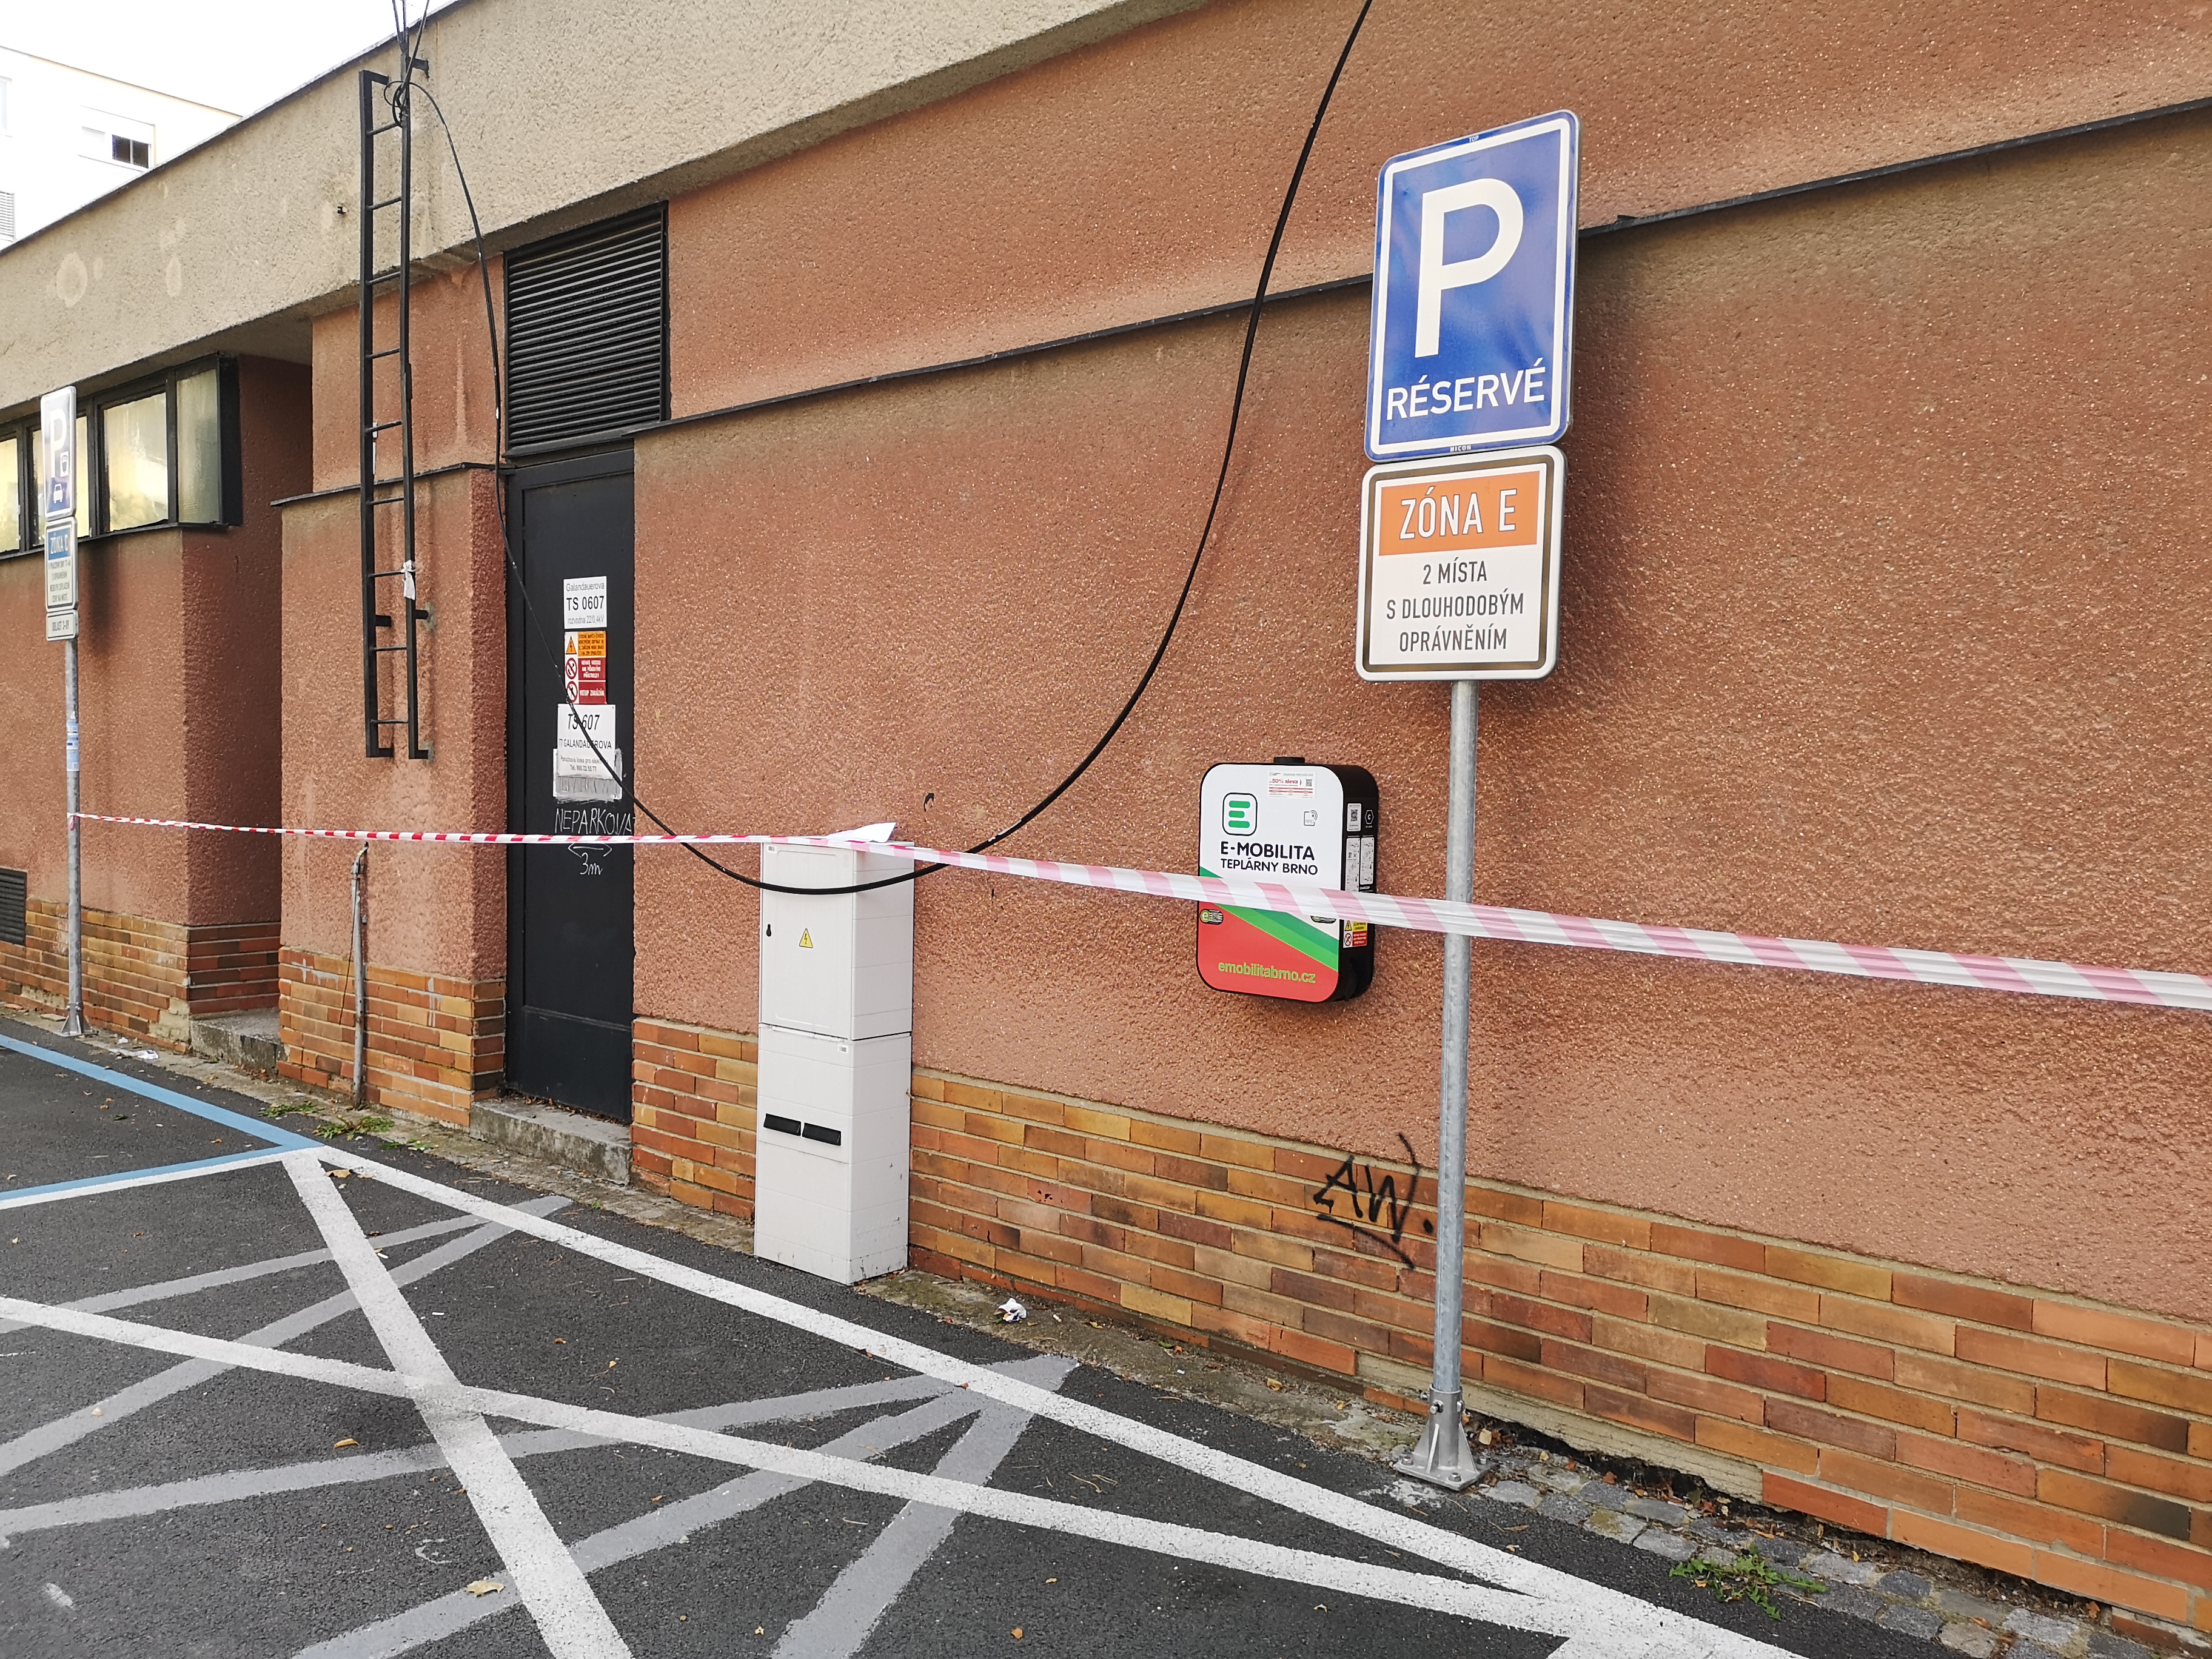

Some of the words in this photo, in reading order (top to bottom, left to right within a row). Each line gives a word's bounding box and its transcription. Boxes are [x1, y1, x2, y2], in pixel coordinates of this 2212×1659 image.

[1469, 135, 1480, 143] TOP
[1414, 178, 1524, 359] P
[1387, 357, 1546, 420] RÉSERVÉ
[50, 408, 67, 478] P
[1399, 486, 1483, 540] ZÓNA
[1498, 488, 1517, 532] E
[1423, 564, 1432, 585] 2
[1438, 557, 1487, 584] MÍSTA
[566, 583, 604, 591] Galandauerova
[566, 597, 578, 611] TS
[582, 595, 604, 609] 0607
[1386, 600, 1396, 620] S
[1402, 588, 1524, 619] DLOUHODOBÝM
[1399, 623, 1507, 652] OPRÁVNĚNÍM
[568, 714, 579, 729] TS
[582, 714, 600, 730] 607
[563, 739, 612, 749] GALANDAUROVA
[555, 808, 635, 836] NEPARKOVA
[1221, 841, 1315, 860] E-MOBILITA
[580, 853, 603, 876] 3m
[1221, 857, 1279, 872] TEPLÁRNY
[1282, 863, 1318, 875] BRNO
[1218, 962, 1316, 984] emobilitabrno.cz
